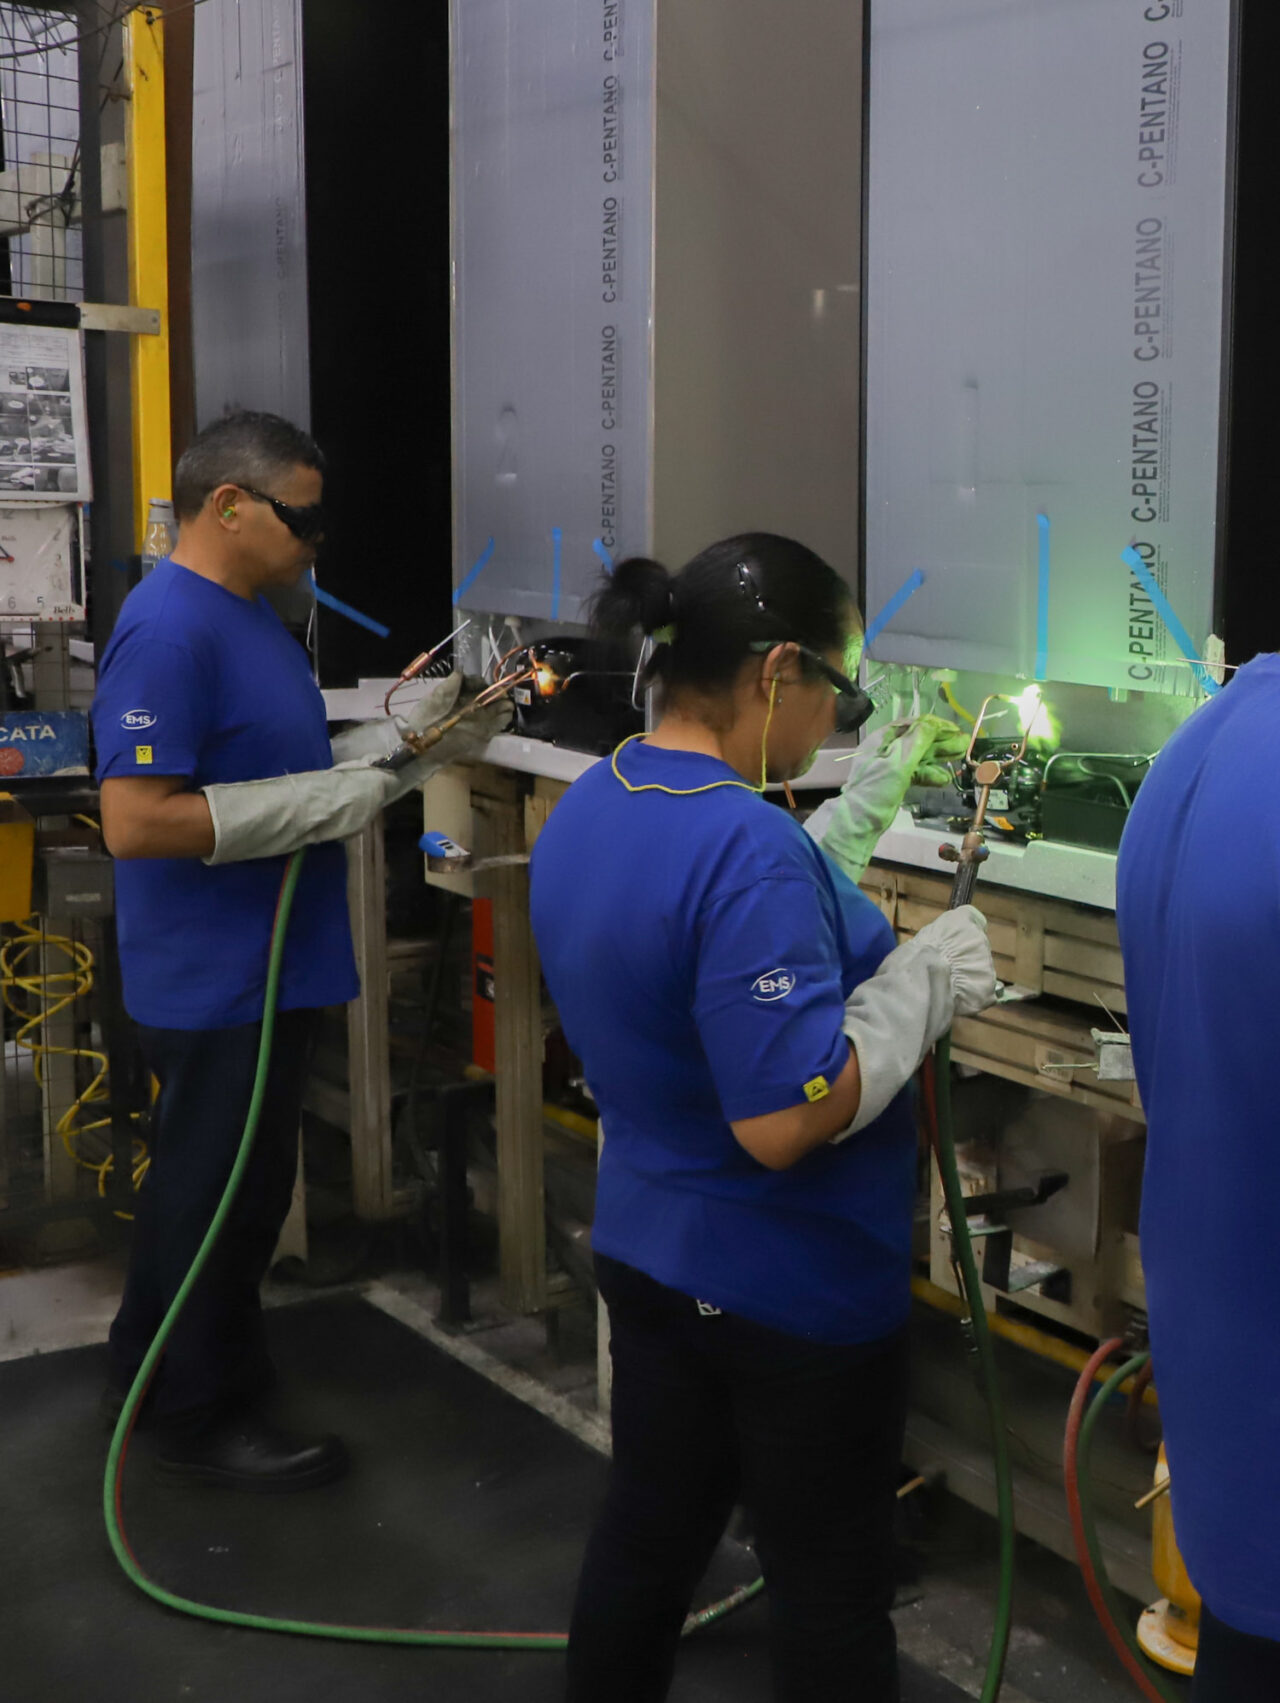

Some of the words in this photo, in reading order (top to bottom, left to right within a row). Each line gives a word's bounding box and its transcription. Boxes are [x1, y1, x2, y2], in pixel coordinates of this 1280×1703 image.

[603, 0, 617, 61] C-PEN
[603, 75, 617, 182] C-PENTANO
[1137, 41, 1169, 188] C-PENTANO
[602, 197, 617, 303] C-PENTANO
[1133, 217, 1163, 362] C-PENTANO
[602, 325, 616, 430] C-PENTANO
[602, 444, 616, 547] C-PENTANO
[1131, 381, 1160, 523] C-PENTANO
[126, 714, 151, 725] EMS
[759, 976, 790, 992] EMS
